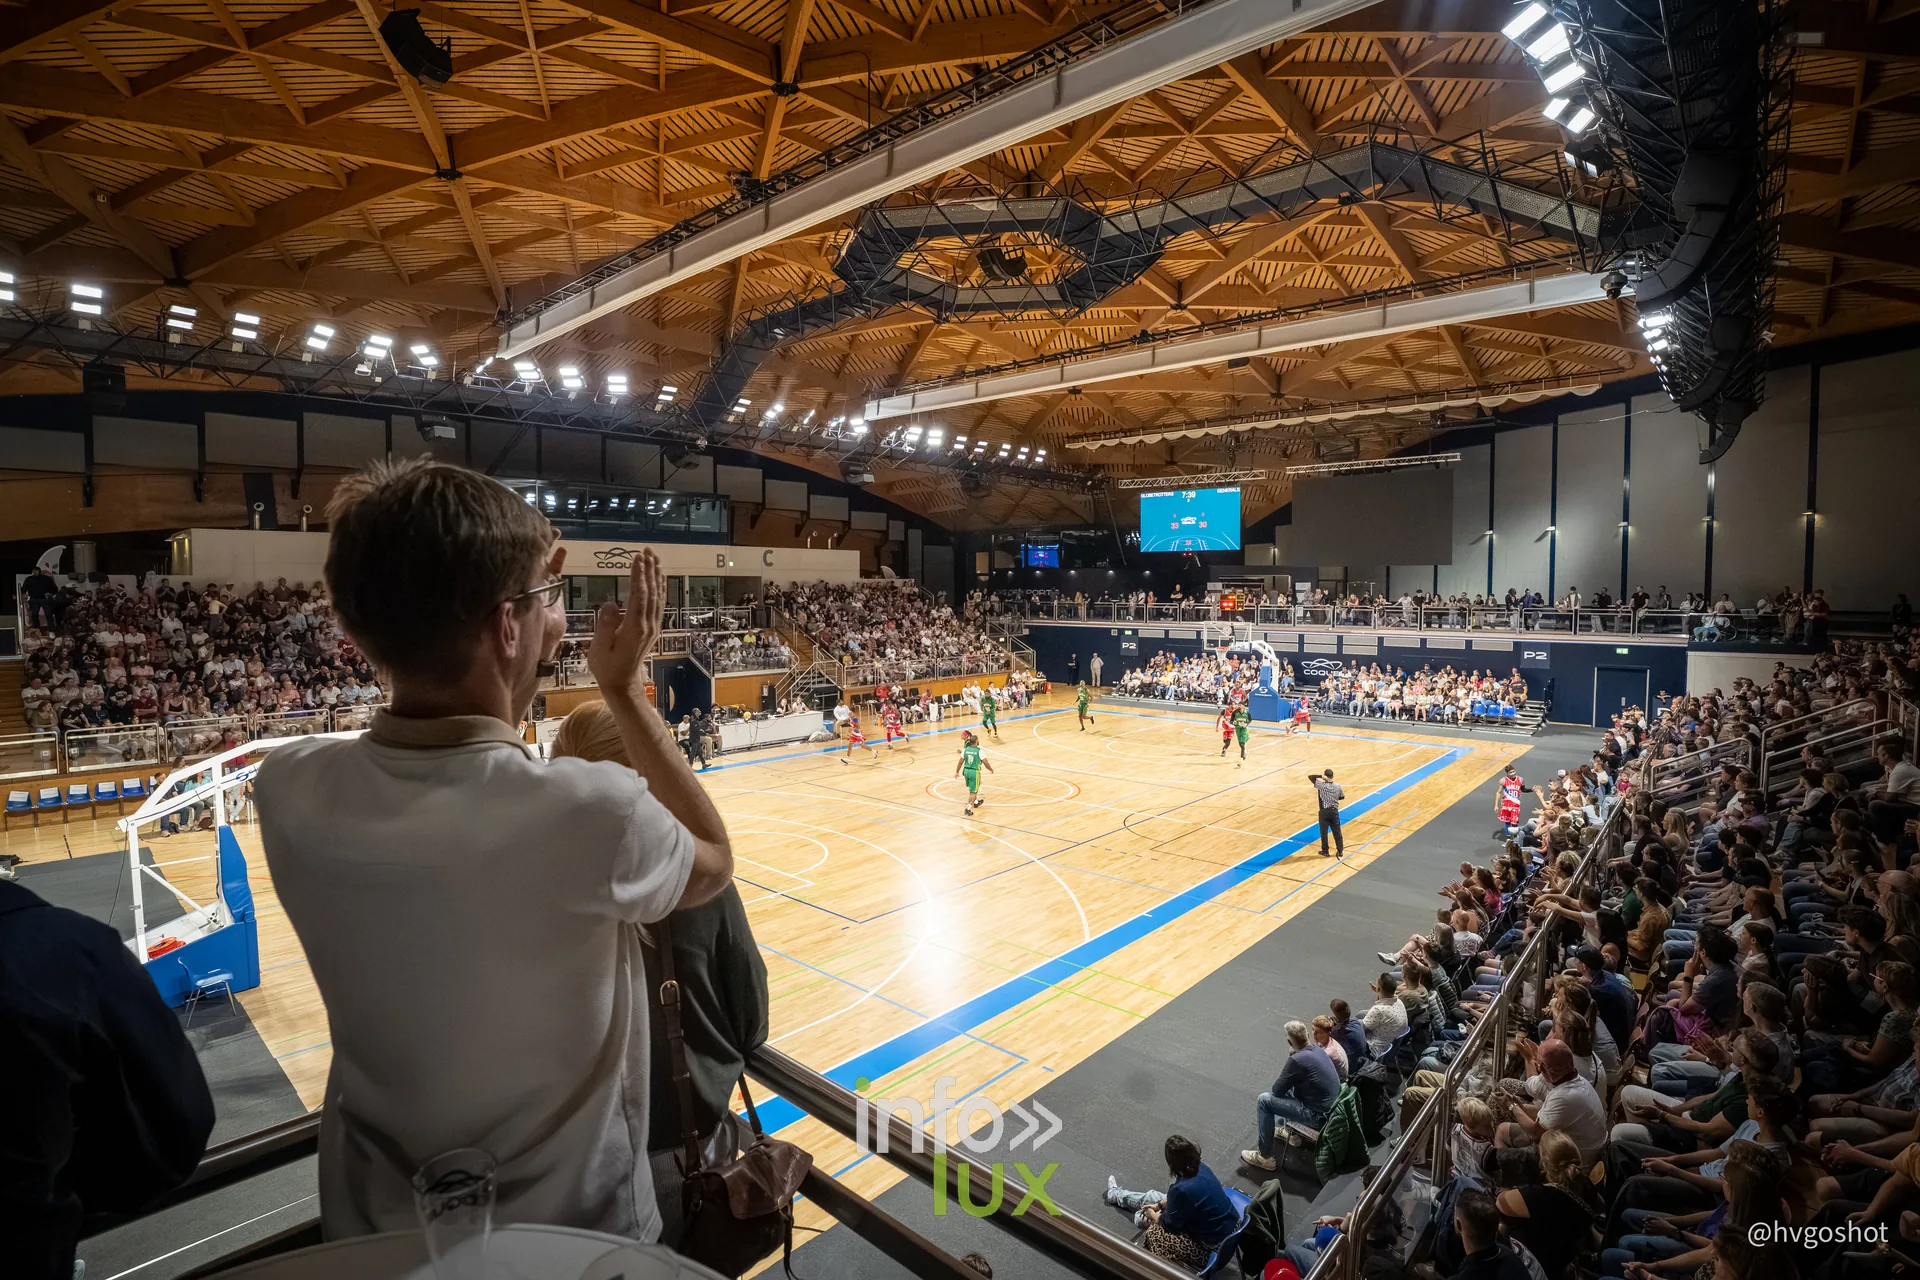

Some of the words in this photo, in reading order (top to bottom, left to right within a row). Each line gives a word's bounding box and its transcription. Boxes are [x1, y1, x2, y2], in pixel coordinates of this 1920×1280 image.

[716, 554, 726, 568] B
[762, 549, 774, 567] C
[597, 561, 632, 569] COQU
[1122, 642, 1137, 650] P2
[1523, 651, 1548, 660] P2
